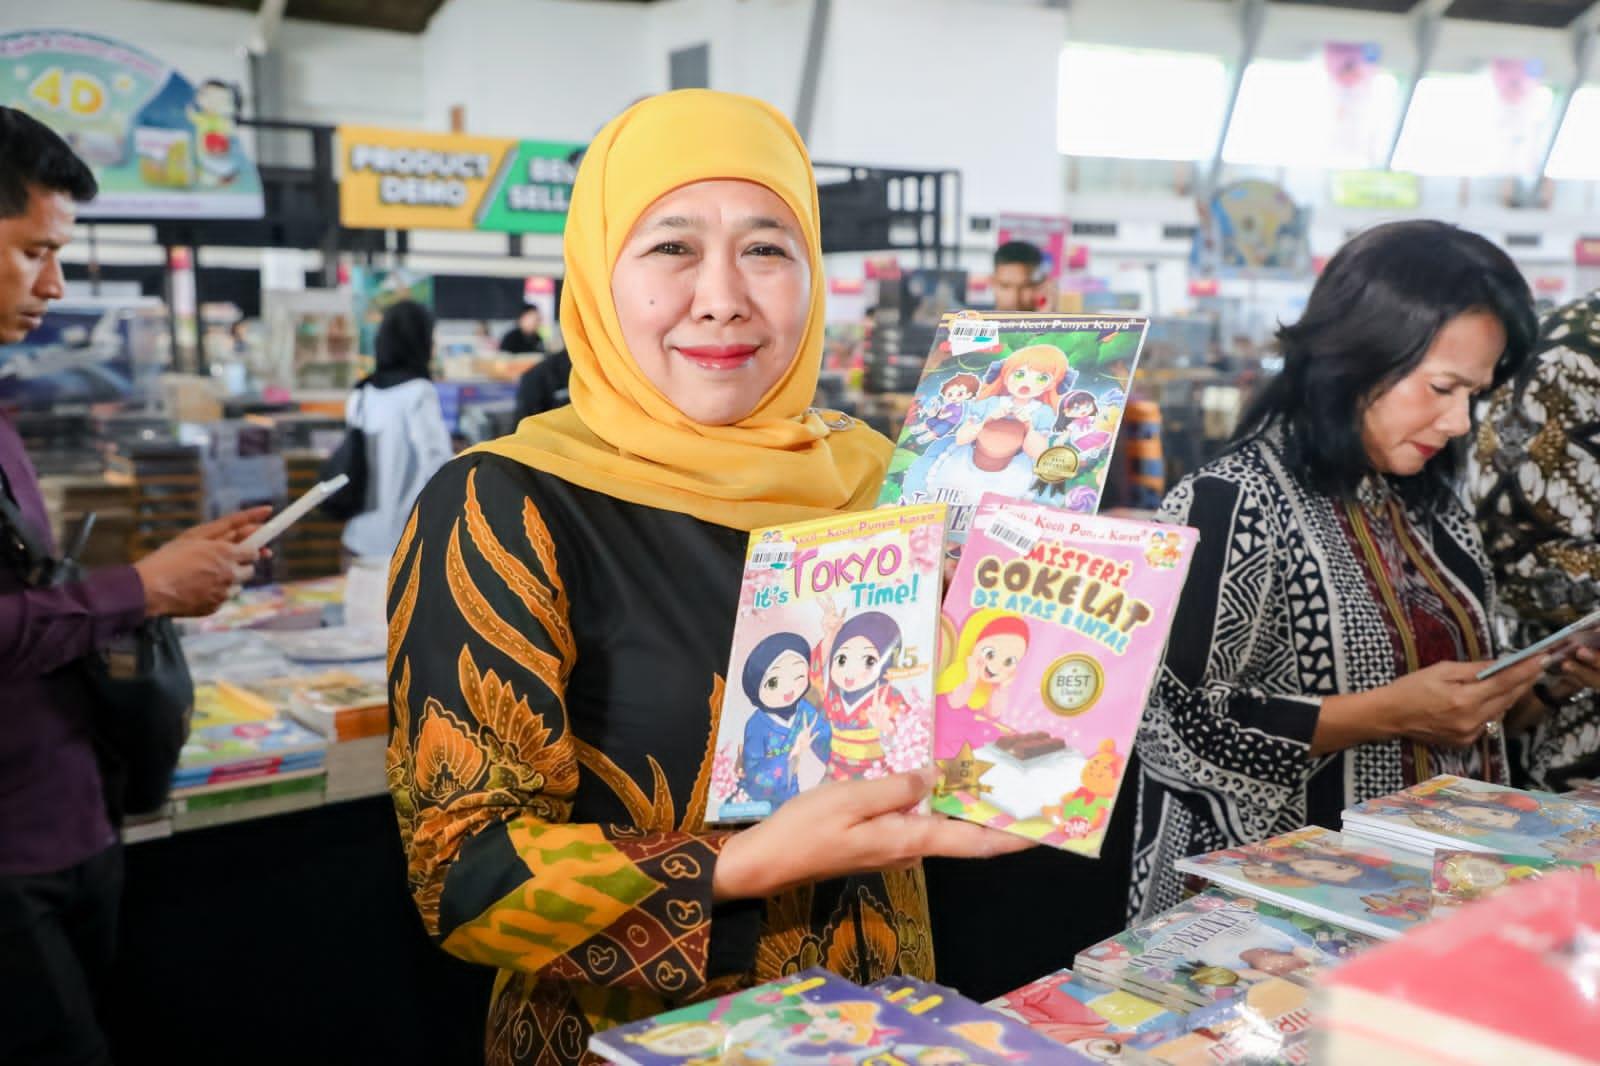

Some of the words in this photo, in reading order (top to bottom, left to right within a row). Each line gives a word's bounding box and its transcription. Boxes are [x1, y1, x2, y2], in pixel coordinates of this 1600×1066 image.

[31, 70, 105, 116] 4D
[352, 146, 491, 177] PRODUCT
[381, 177, 466, 207] DEMO
[1050, 319, 1090, 331] Punya
[791, 543, 903, 598] TOKYO
[755, 586, 789, 609] It's
[851, 573, 919, 609] Time!
[974, 589, 999, 608] DI
[1005, 594, 1057, 620] ATAS
[977, 558, 1151, 633] COKELAT
[1056, 674, 1091, 688] BEST
